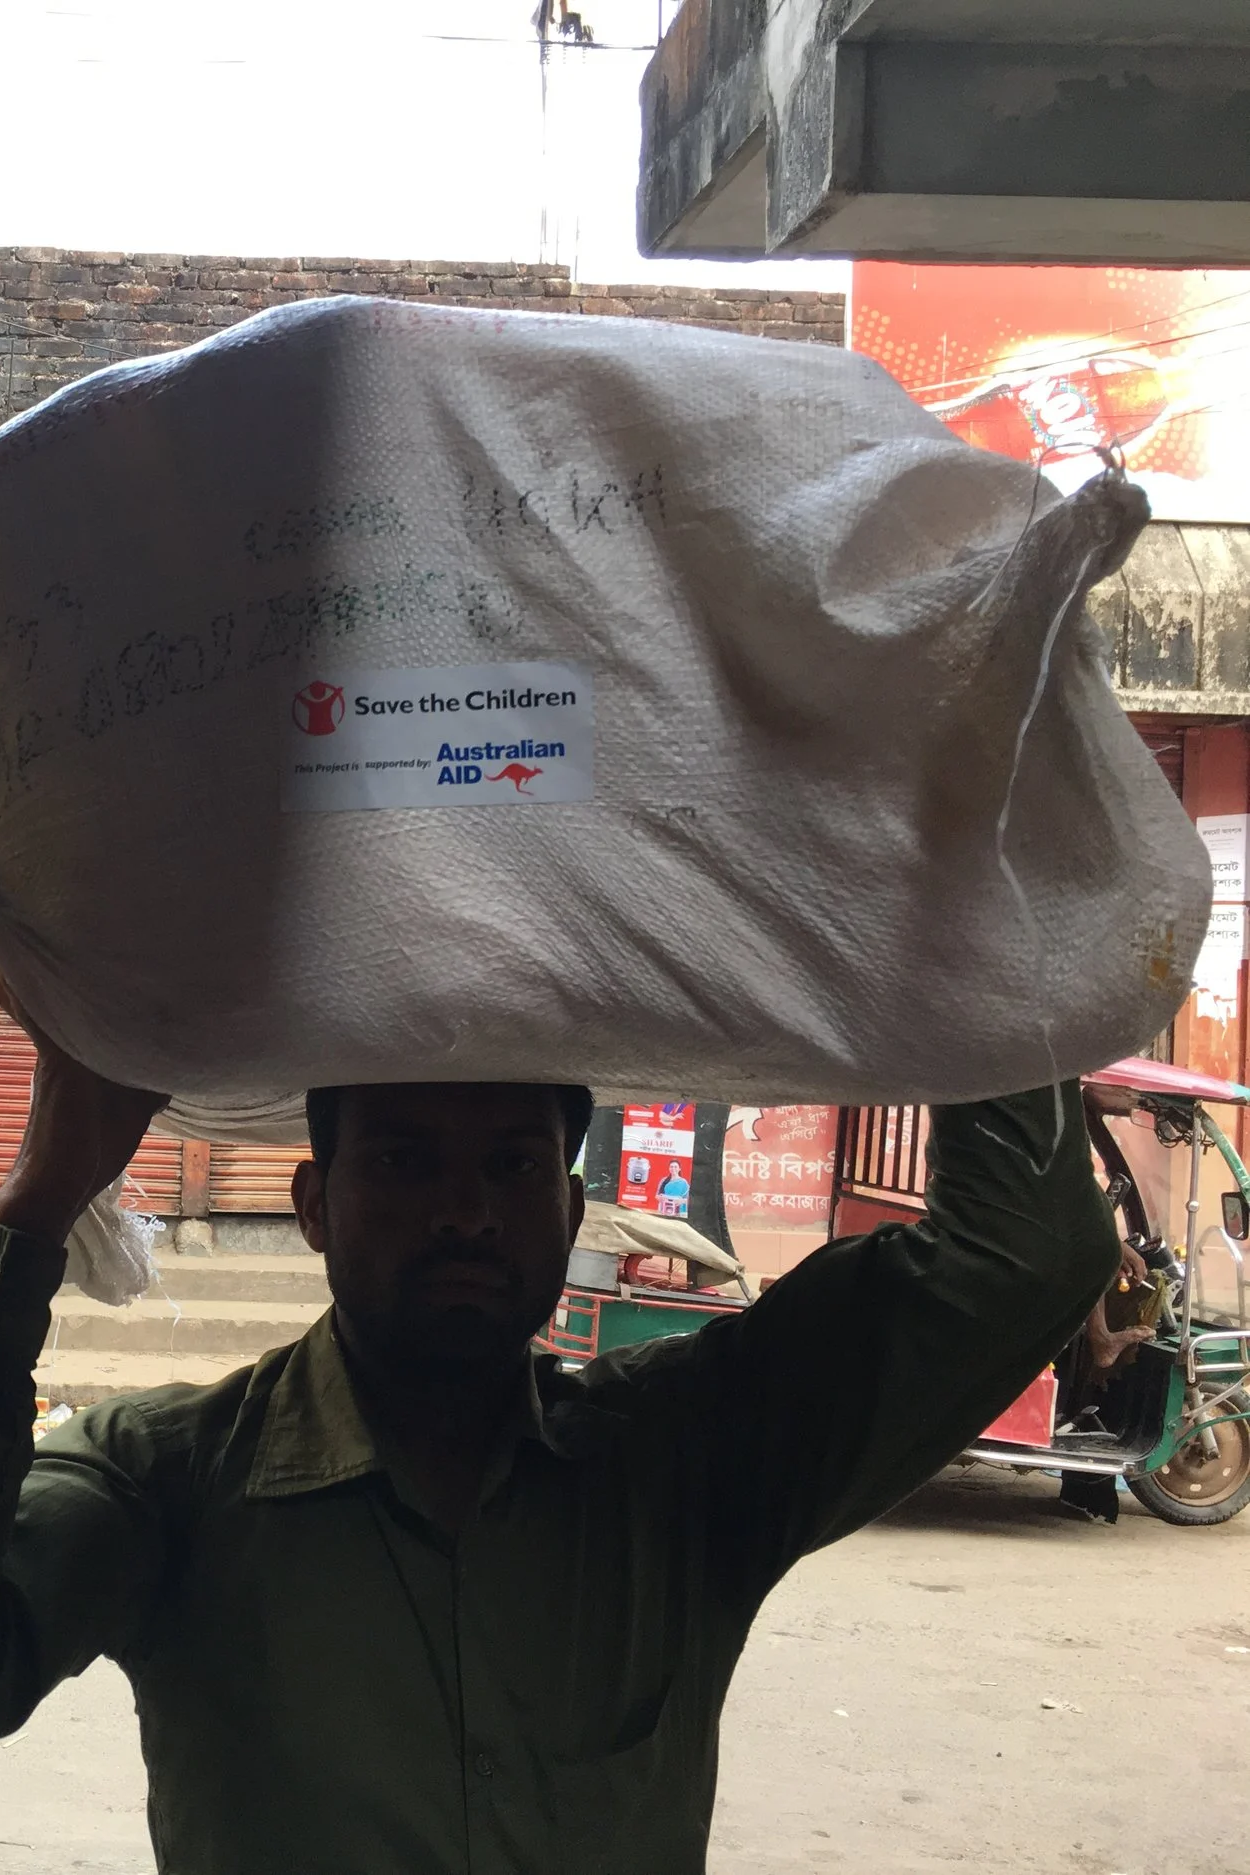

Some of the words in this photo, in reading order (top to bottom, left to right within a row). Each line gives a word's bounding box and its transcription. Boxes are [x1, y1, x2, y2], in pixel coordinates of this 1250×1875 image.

[355, 696, 414, 716] Save
[419, 693, 460, 713] the
[465, 688, 577, 711] Children
[436, 740, 566, 762] Australian
[315, 762, 350, 774] Project
[351, 762, 359, 771] is
[365, 759, 415, 770] supported
[417, 759, 431, 770] by:
[437, 765, 482, 785] AID
[722, 1150, 773, 1180] মিষ্টি
